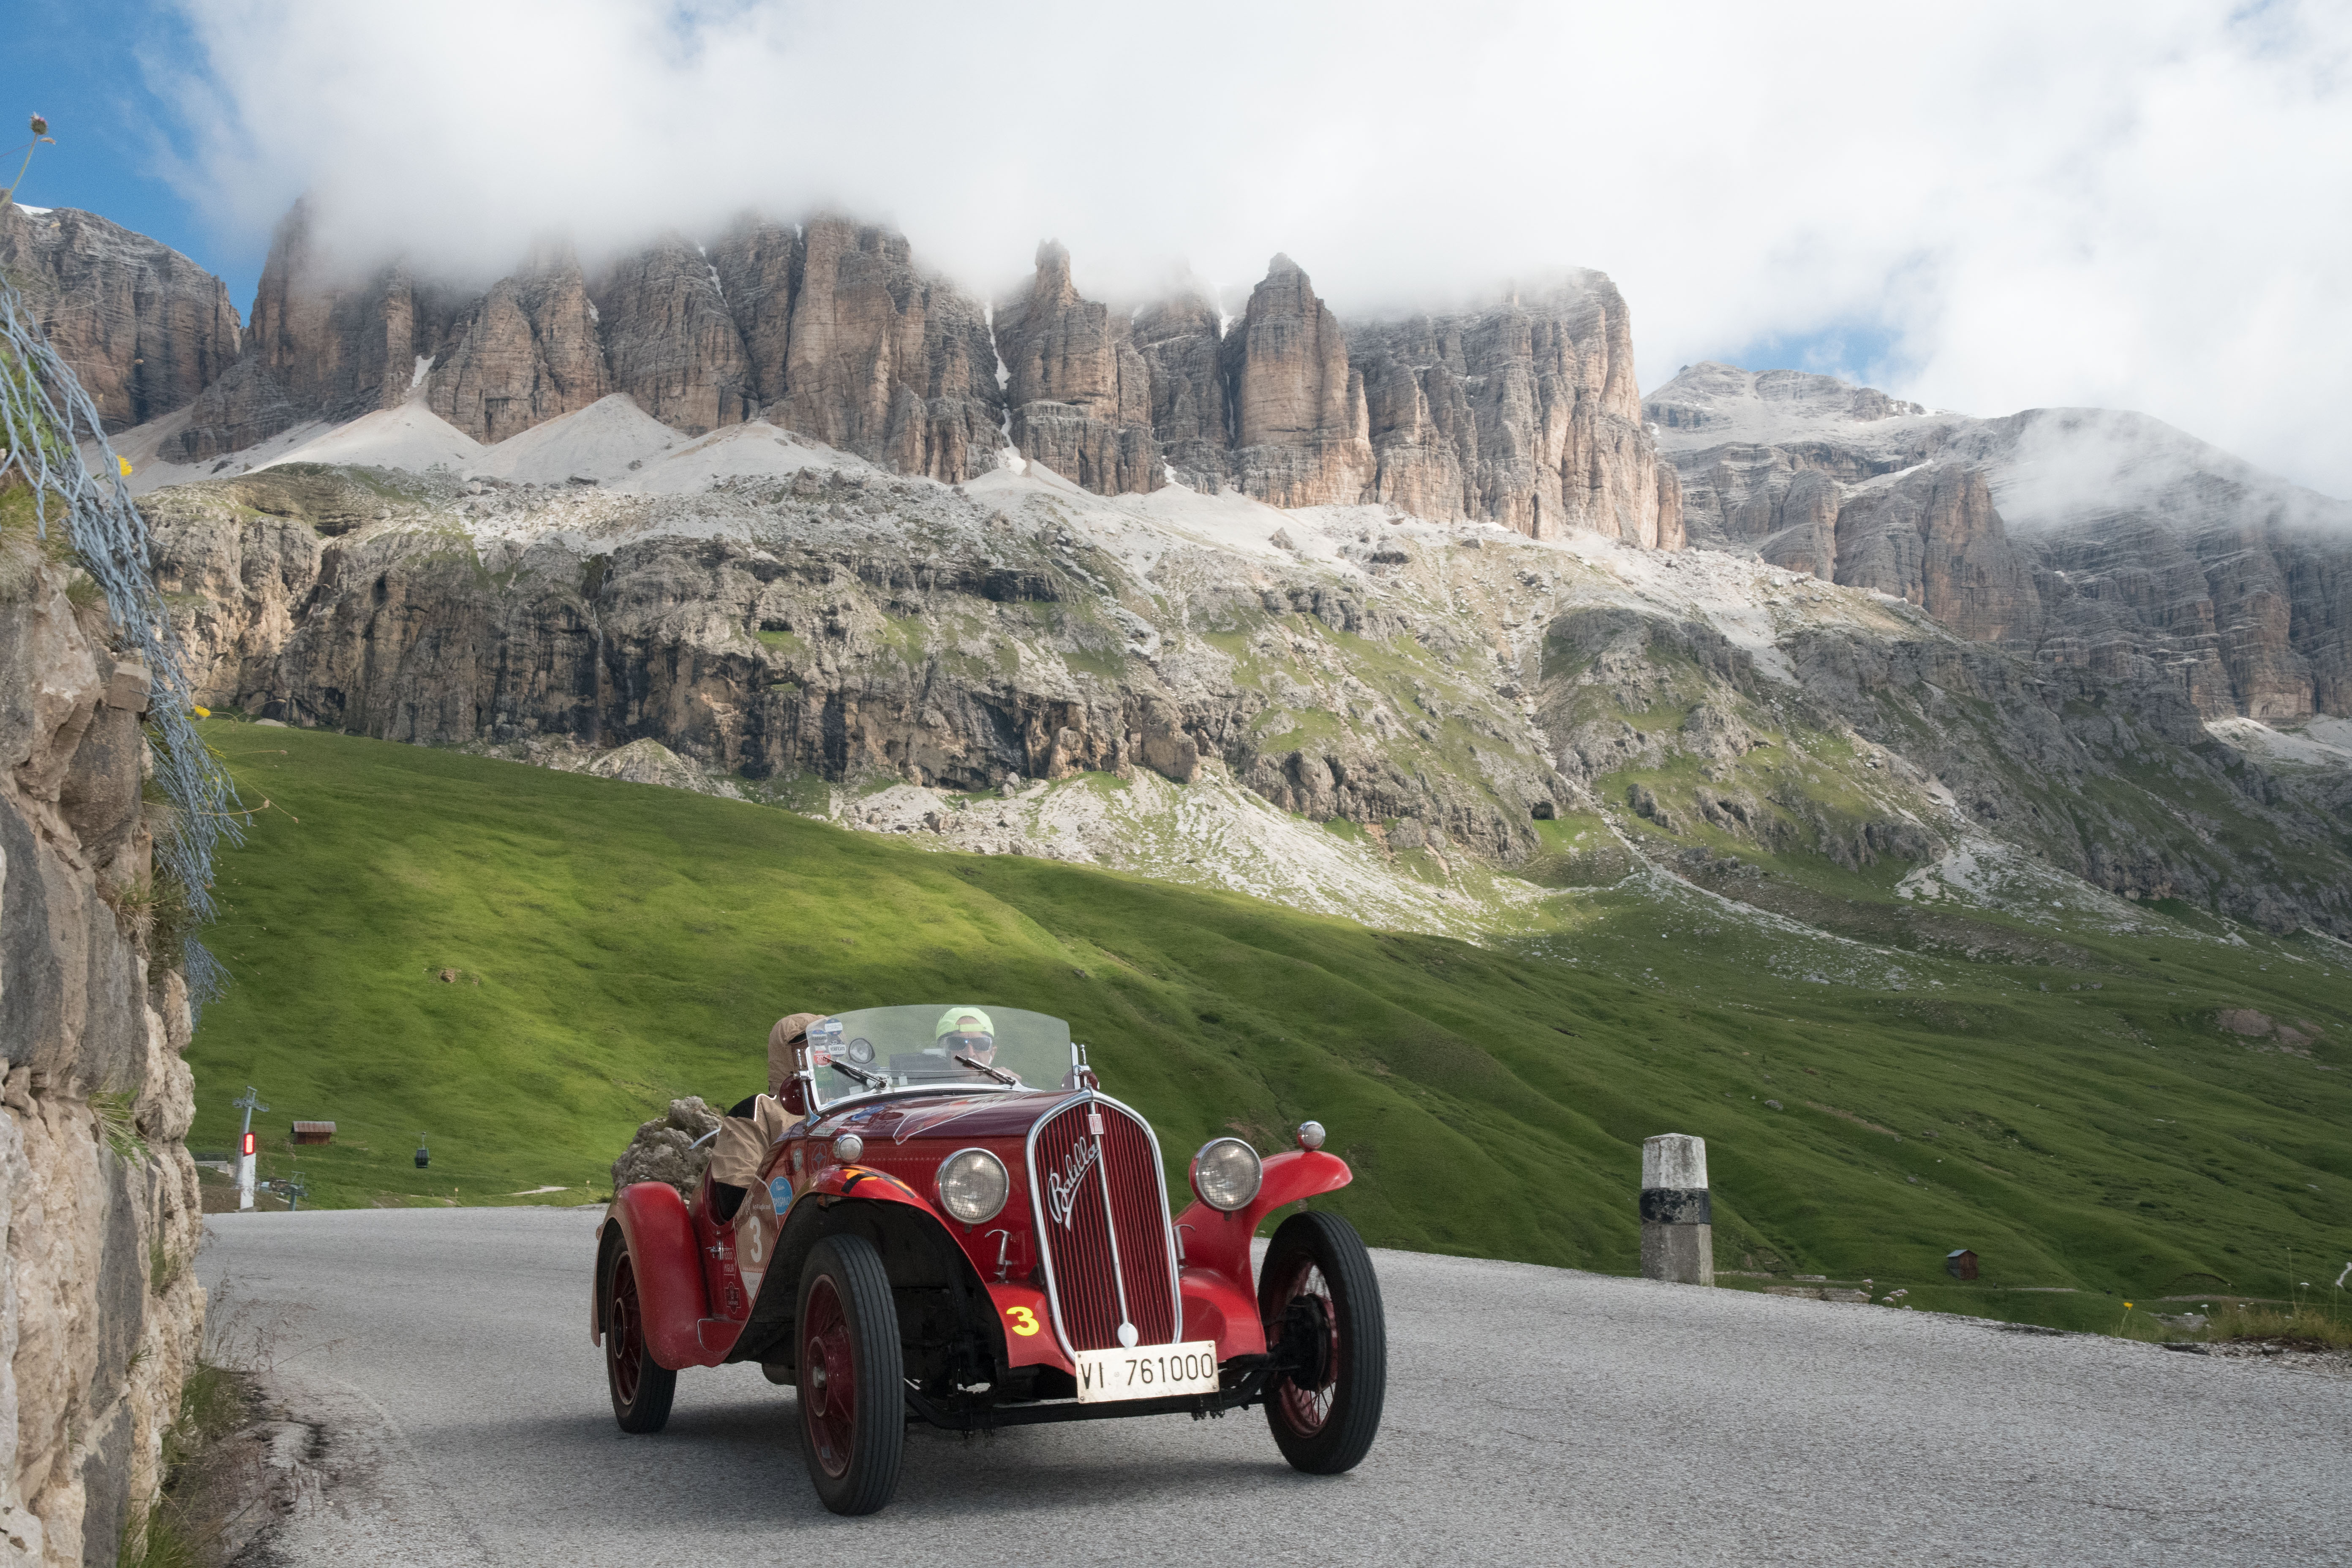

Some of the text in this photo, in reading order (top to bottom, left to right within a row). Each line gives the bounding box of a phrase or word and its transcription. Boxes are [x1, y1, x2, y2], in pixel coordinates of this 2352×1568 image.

[1048, 1136, 1100, 1231] Balilla
[724, 1252, 732, 1260] 1000
[750, 1216, 762, 1263] 3
[1006, 1307, 1040, 1336] 3
[1081, 1353, 1213, 1389] VI 761000
